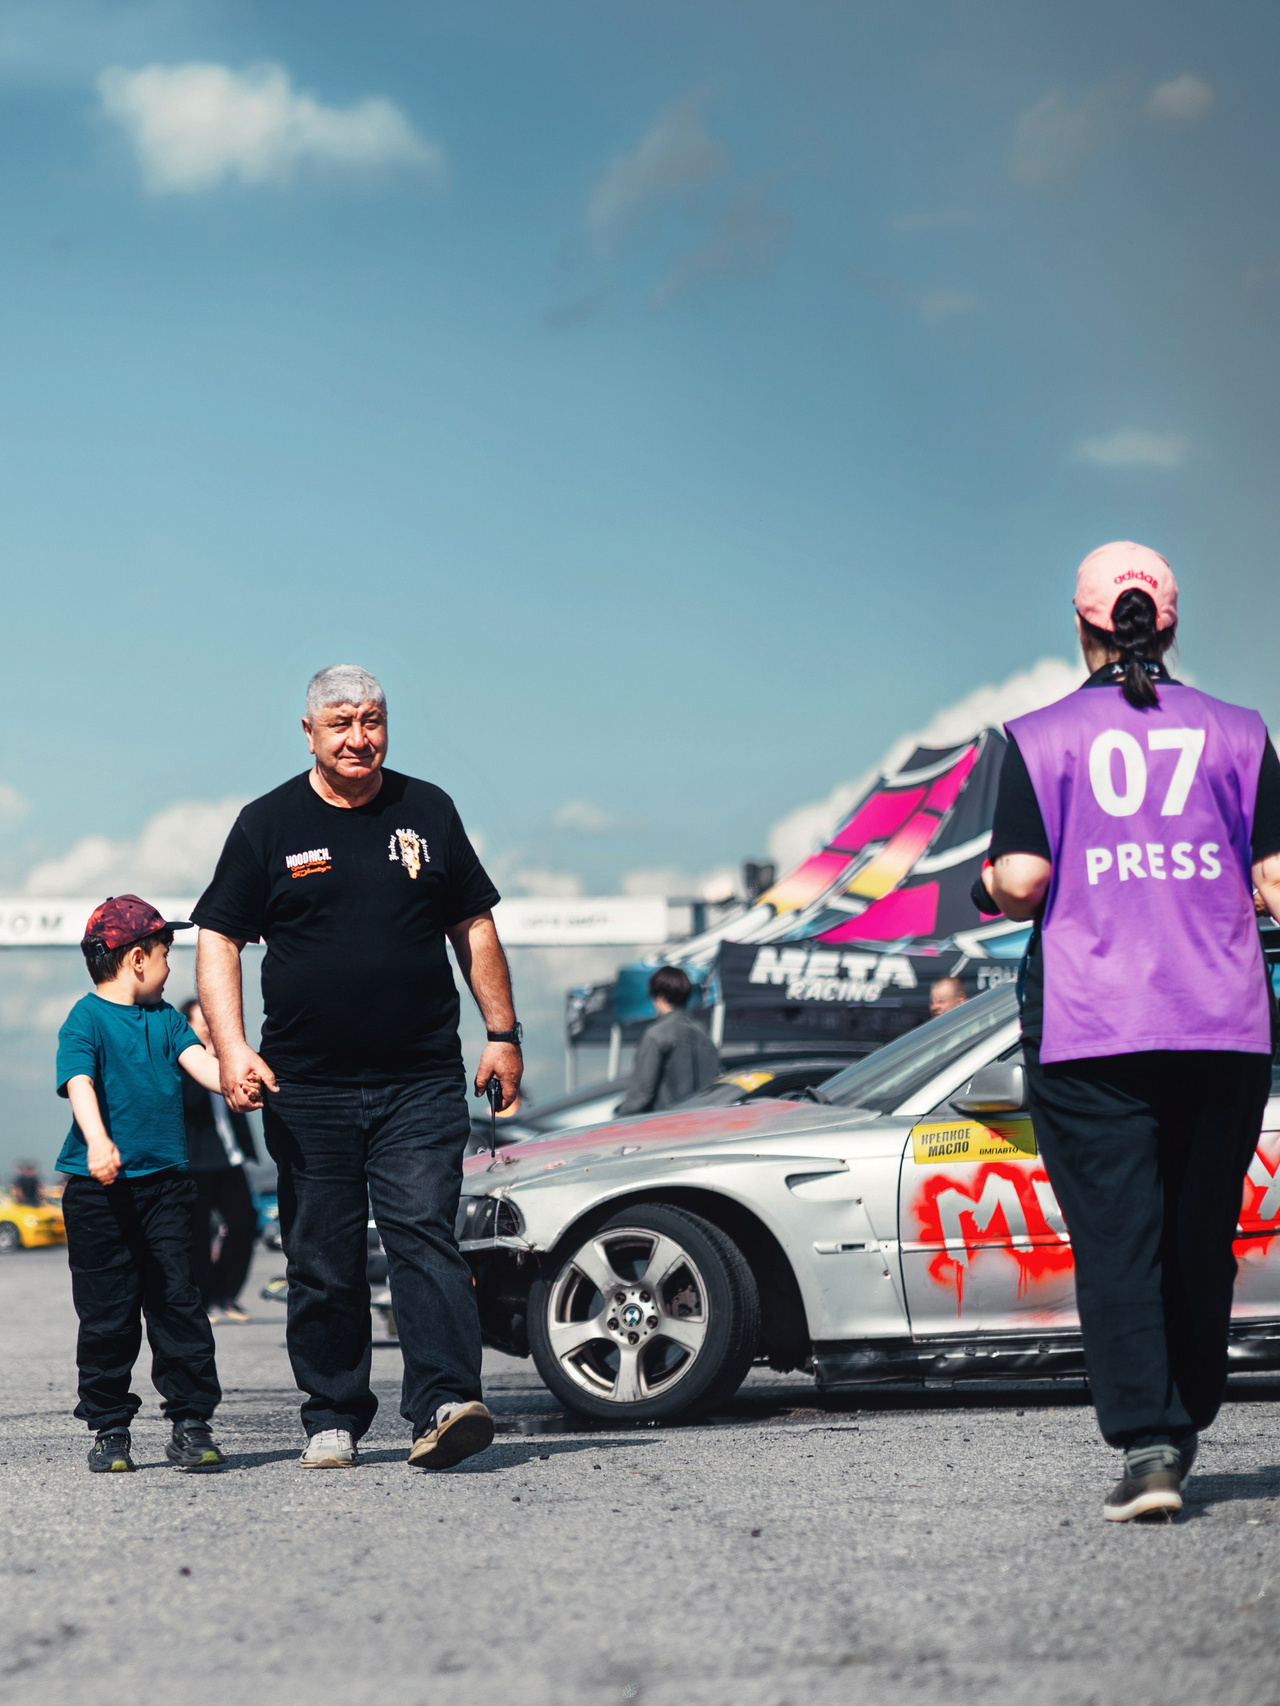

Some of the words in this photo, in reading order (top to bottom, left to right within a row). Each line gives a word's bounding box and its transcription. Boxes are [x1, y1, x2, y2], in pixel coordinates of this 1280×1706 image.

[1114, 569, 1158, 589] adidas
[1089, 728, 1206, 817] 07
[1086, 842, 1222, 885] PRESS
[748, 946, 918, 989] META
[785, 976, 882, 1001] RACING
[921, 1128, 971, 1145] КРЕПКОЕ
[928, 1141, 970, 1157] МАСЛО
[979, 1147, 1019, 1155] ВМПАВТО
